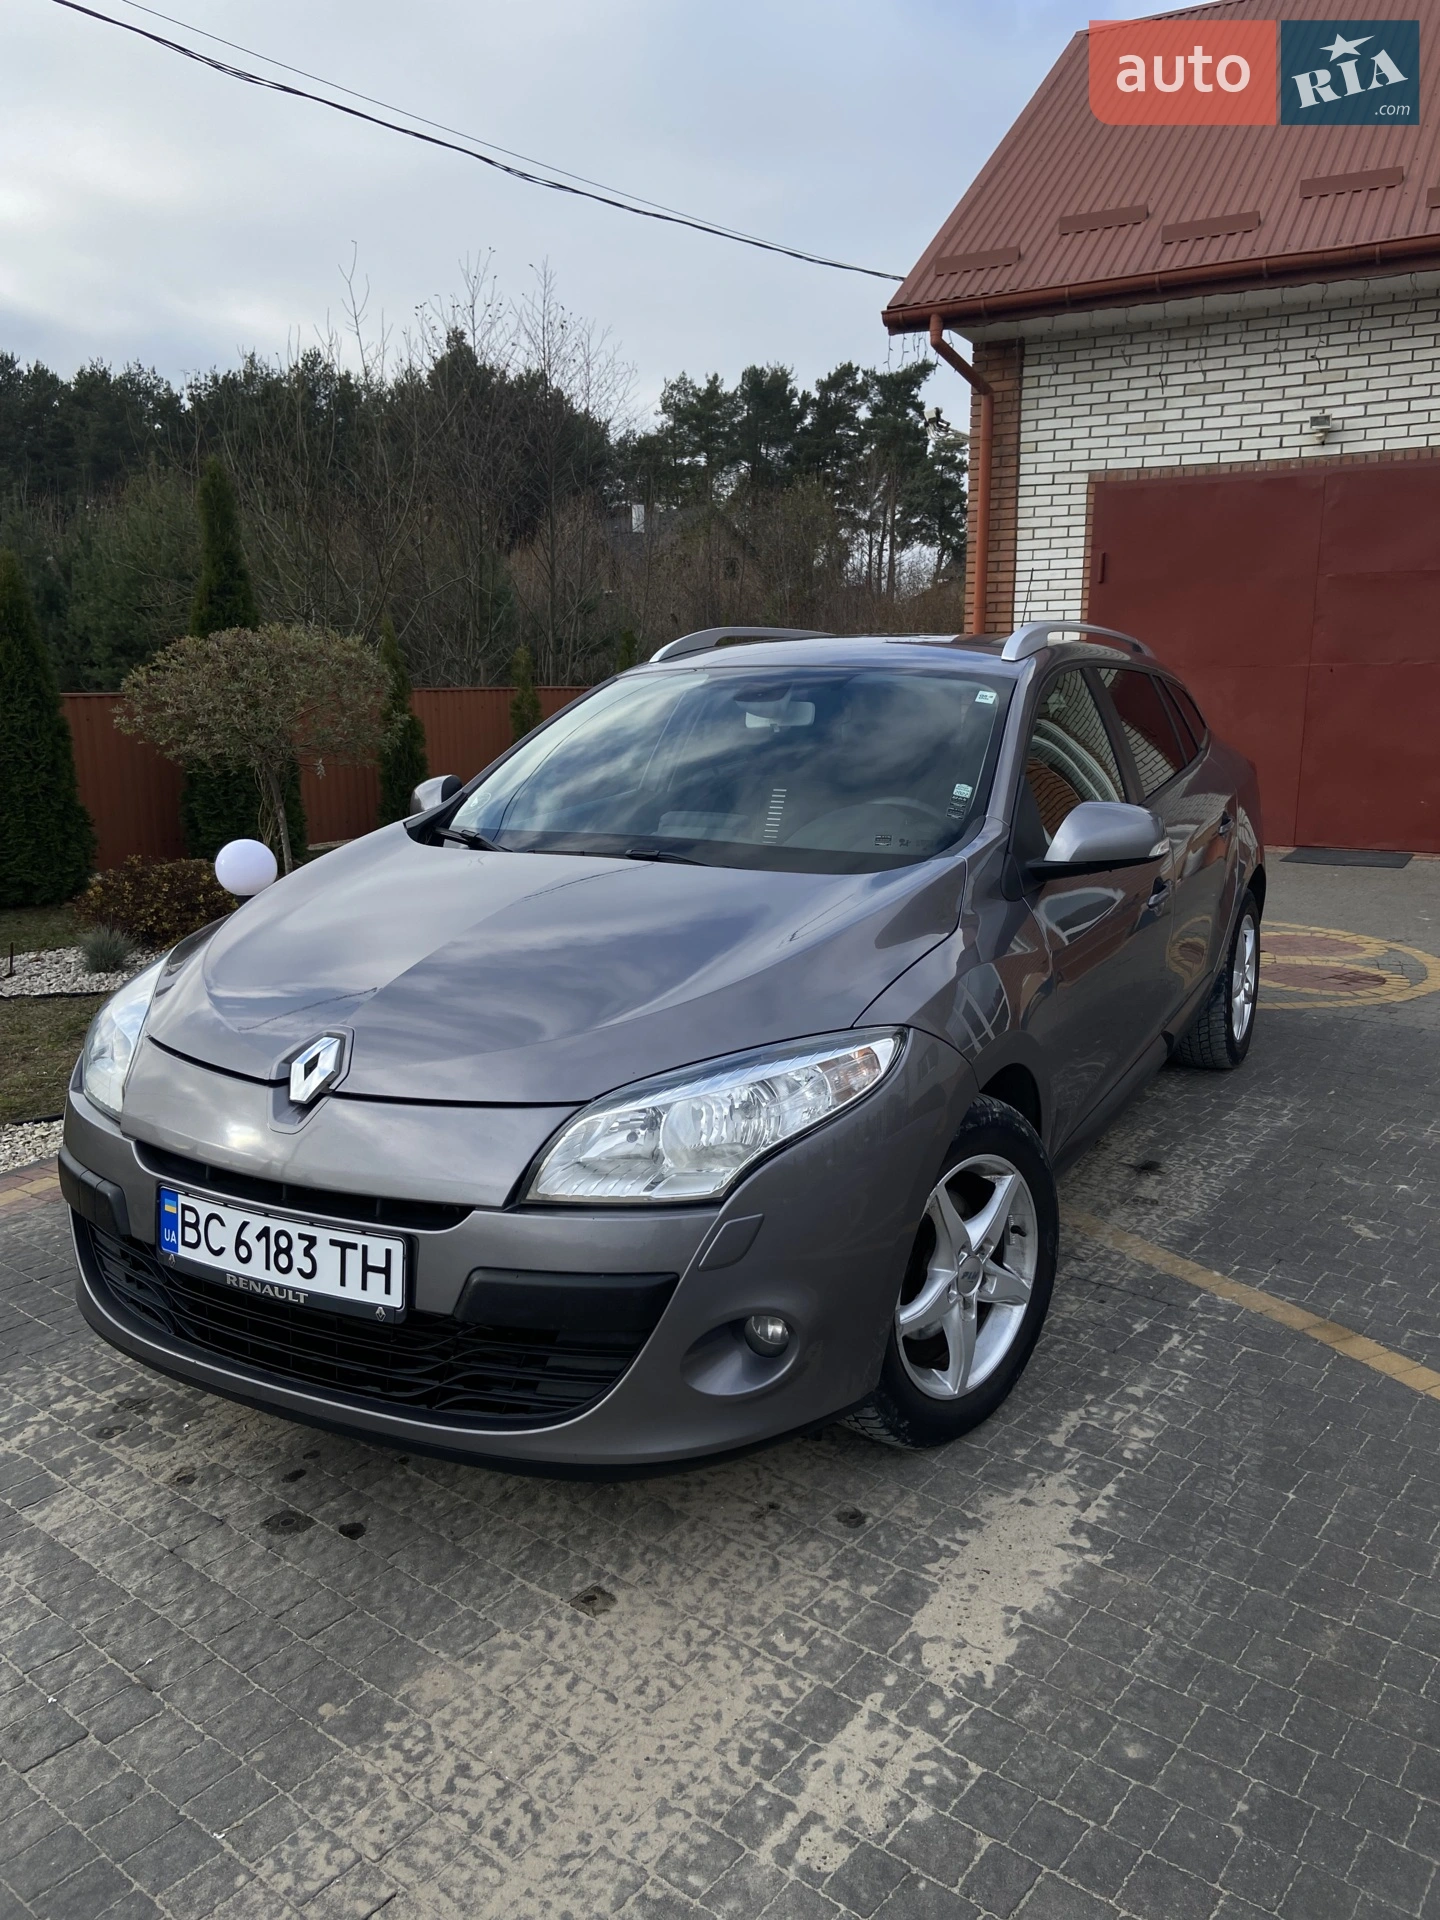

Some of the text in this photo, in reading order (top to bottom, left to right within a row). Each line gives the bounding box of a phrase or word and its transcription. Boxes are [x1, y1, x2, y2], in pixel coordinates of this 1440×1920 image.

[164, 1227, 177, 1245] UA
[180, 1203, 392, 1295] BC 6183 TH
[226, 1273, 309, 1304] RENAULT
